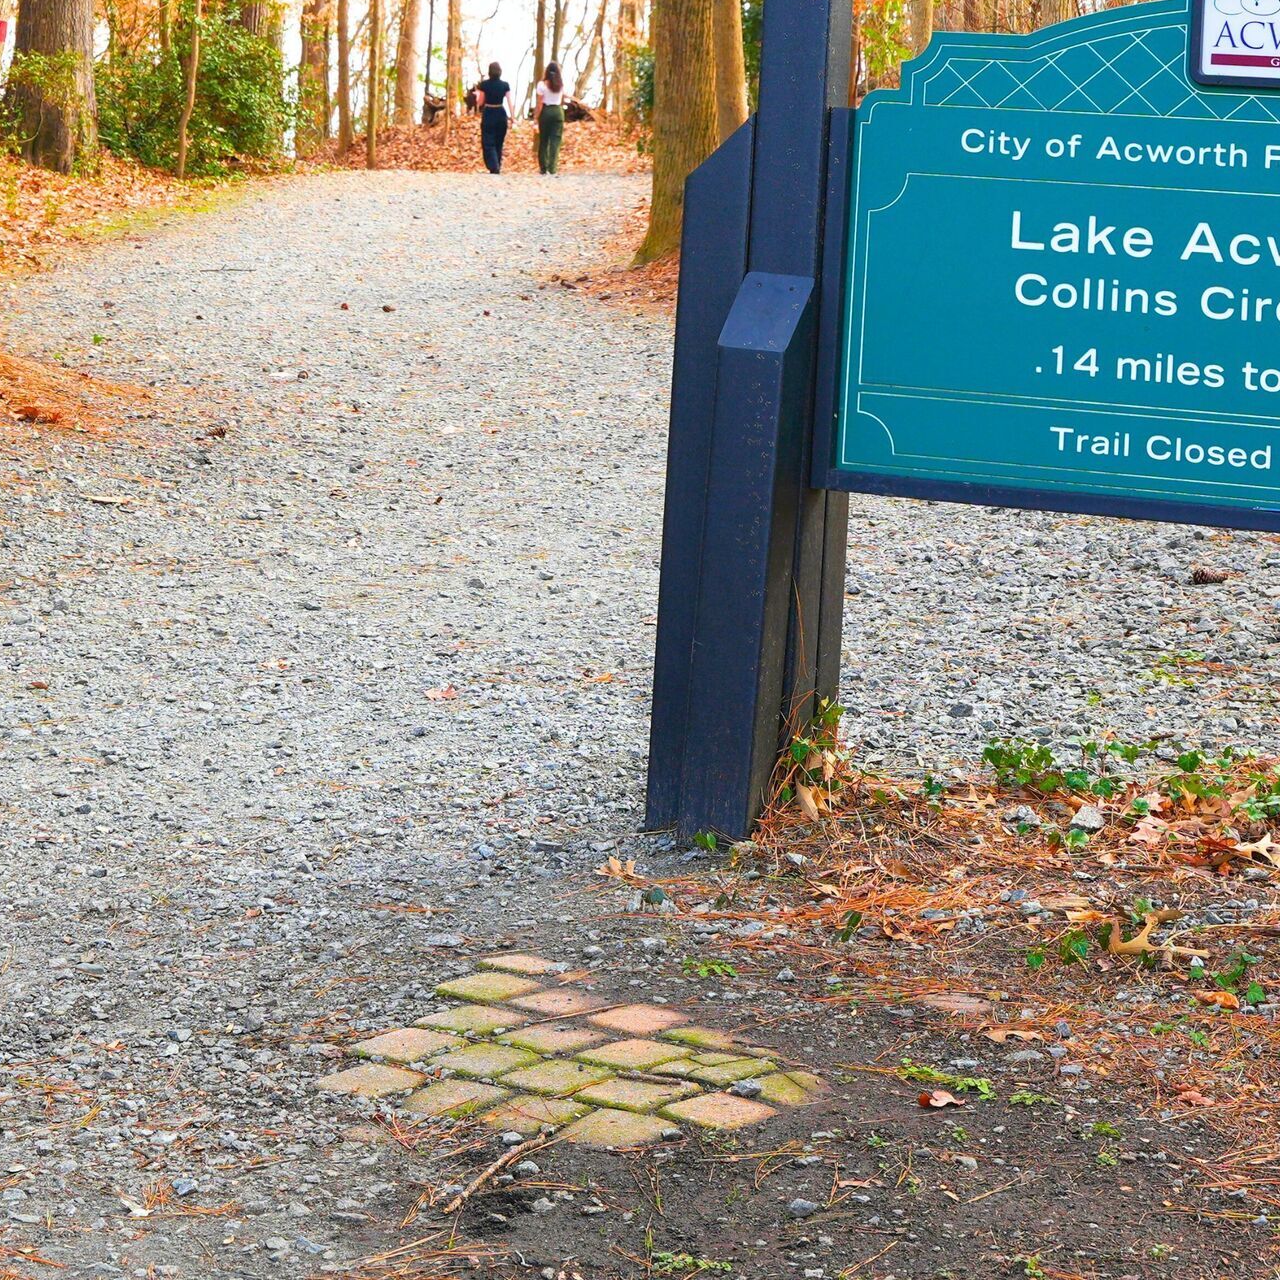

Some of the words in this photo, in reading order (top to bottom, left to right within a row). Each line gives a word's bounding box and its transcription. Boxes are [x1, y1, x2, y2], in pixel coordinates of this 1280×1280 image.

[962, 129, 1030, 160] City
[1046, 135, 1082, 157] of
[1096, 137, 1247, 167] Acworth
[1012, 211, 1153, 257] Lake
[1016, 274, 1177, 315] Collins
[1036, 346, 1098, 376] .14
[1117, 355, 1224, 387] miles
[1050, 427, 1129, 456] Trail
[1147, 436, 1271, 469] Closed
